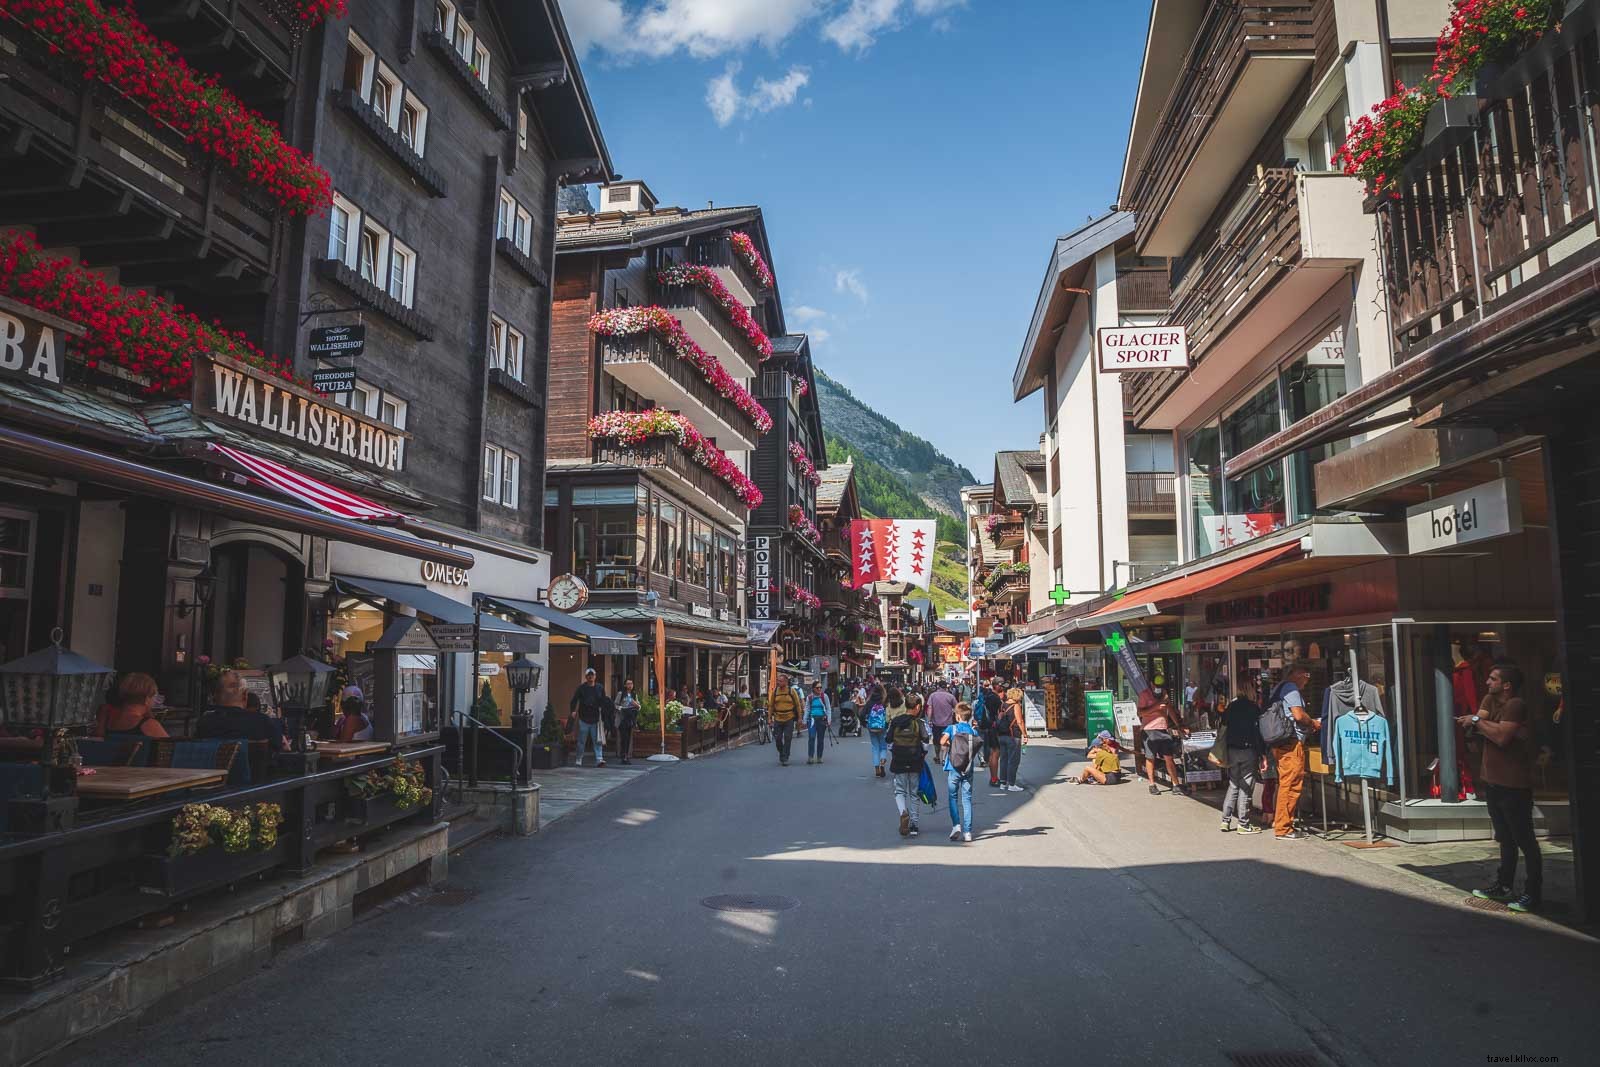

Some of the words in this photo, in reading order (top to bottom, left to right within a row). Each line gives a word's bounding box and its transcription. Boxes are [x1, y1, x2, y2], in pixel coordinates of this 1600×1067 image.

[326, 334, 348, 342] HOTEL
[1105, 333, 1180, 347] GLACIER
[310, 341, 363, 351] WALLISERHOF
[1116, 349, 1171, 363] SPORT
[314, 372, 355, 381] THEODORS
[313, 381, 353, 391] STUBA
[213, 364, 400, 471] WALLISERHOF
[1431, 498, 1477, 538] hotel
[423, 561, 470, 586] OMEGA
[757, 538, 768, 617] POLLUX
